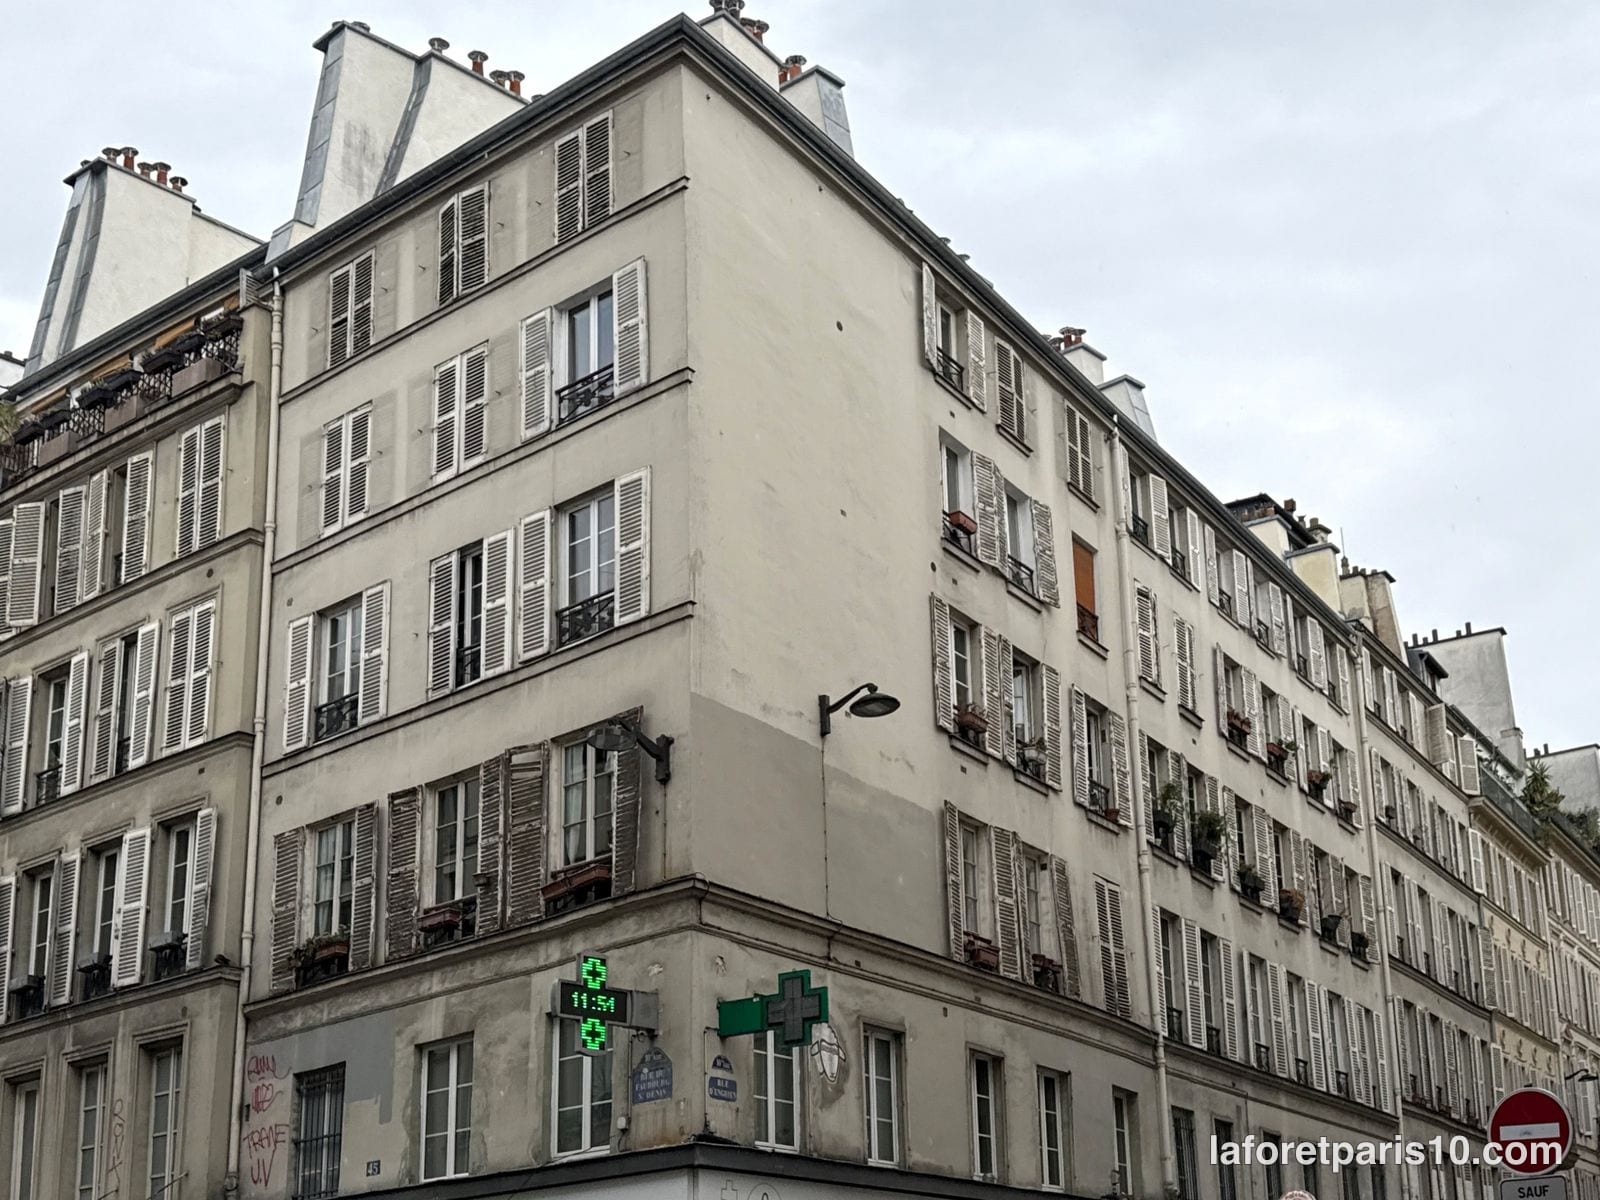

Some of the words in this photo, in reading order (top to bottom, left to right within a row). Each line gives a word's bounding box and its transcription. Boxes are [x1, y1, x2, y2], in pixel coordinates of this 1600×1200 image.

[635, 1079, 670, 1091] FAUBOURG
[716, 1079, 729, 1088] RUE
[367, 1162, 379, 1176] 45
[1517, 1185, 1550, 1198] SAUF
